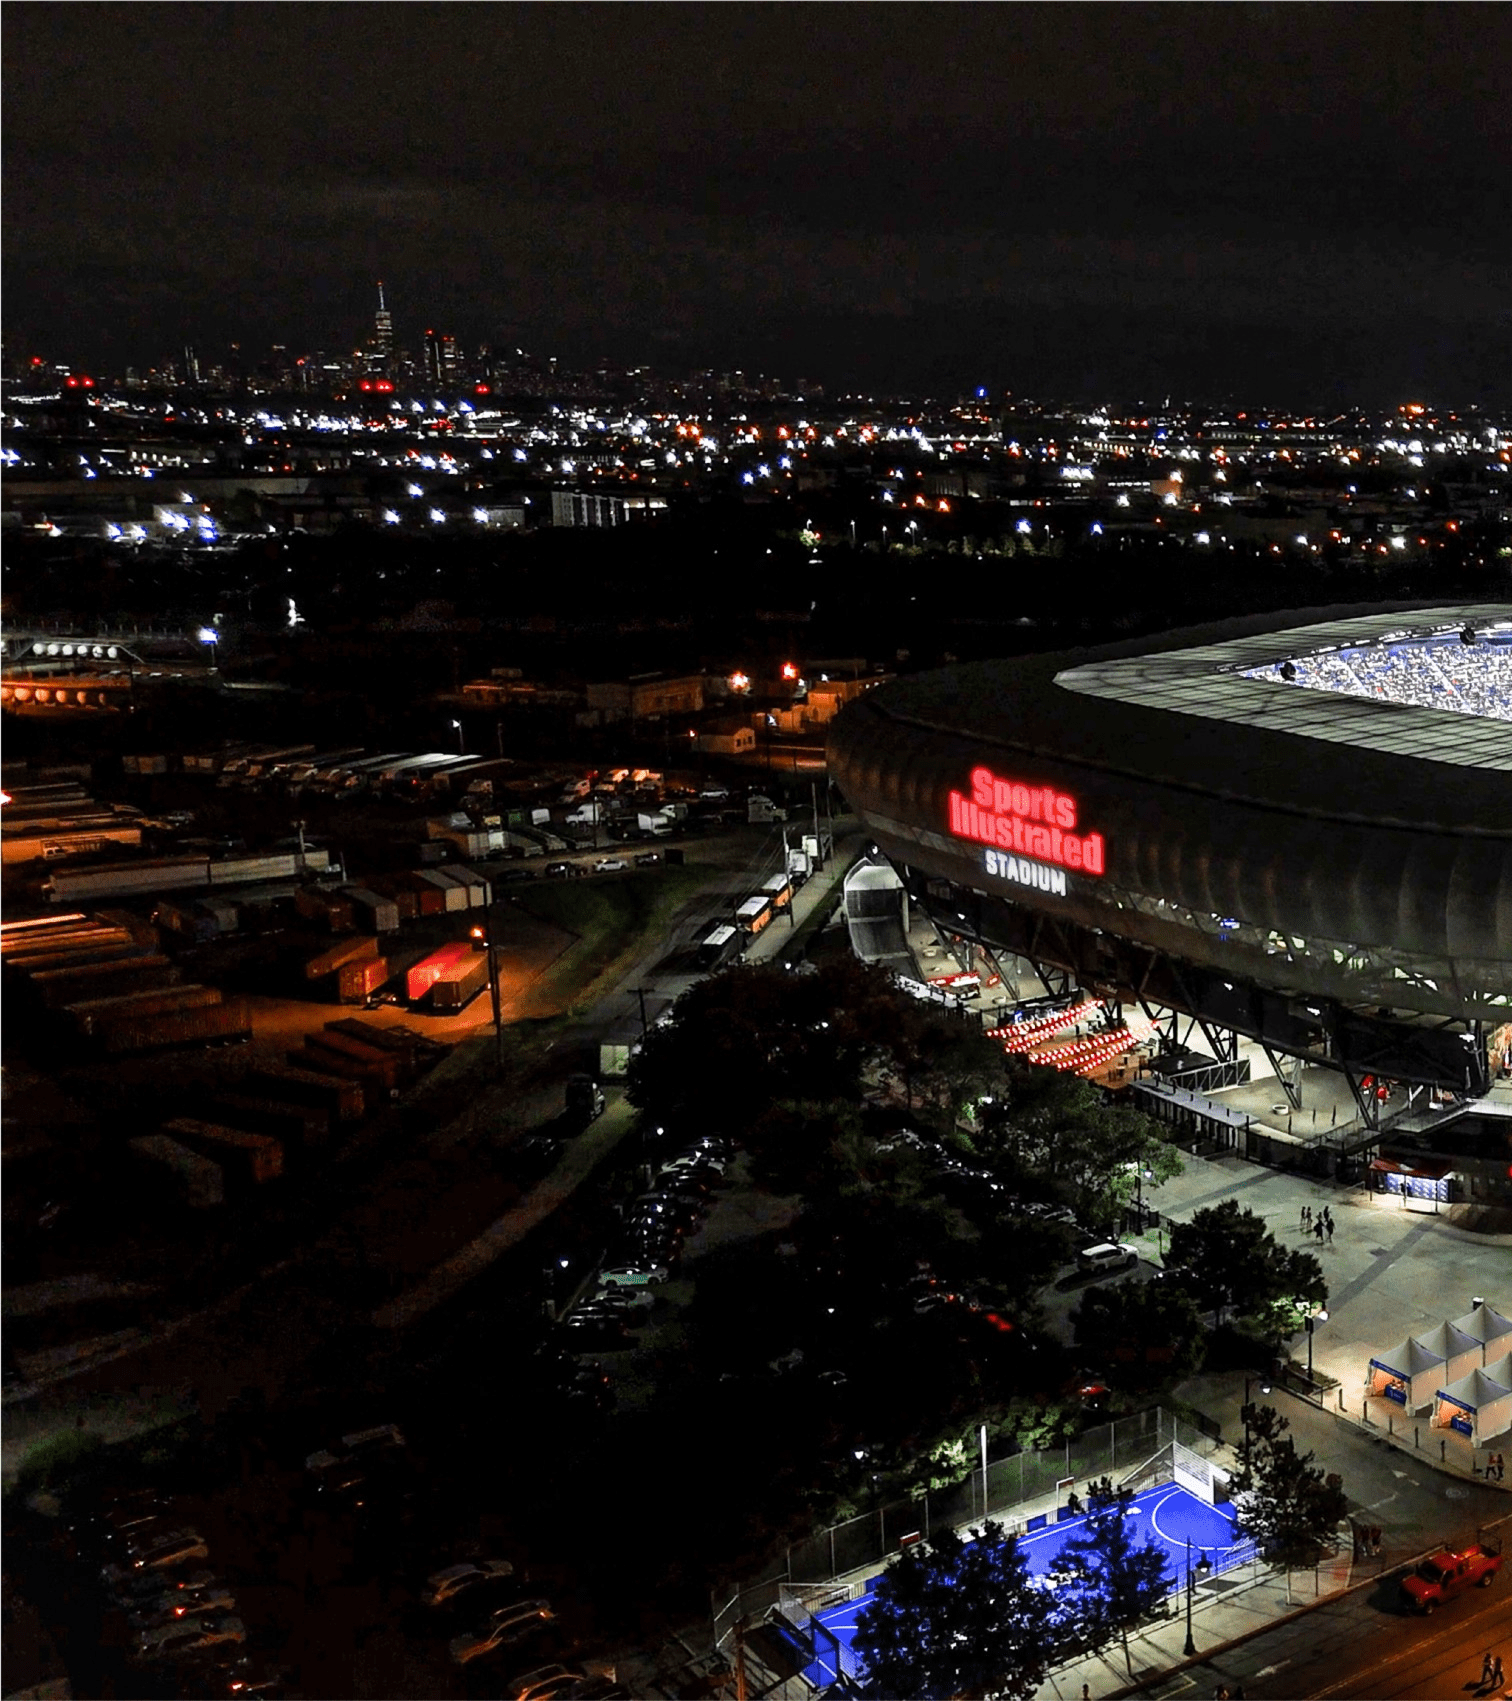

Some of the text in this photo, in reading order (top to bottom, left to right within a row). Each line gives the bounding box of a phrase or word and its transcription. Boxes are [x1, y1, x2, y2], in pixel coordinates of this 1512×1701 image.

[970, 767, 1076, 829] Sports
[949, 790, 1105, 875] Illustrated
[985, 849, 1067, 896] STADIUM
